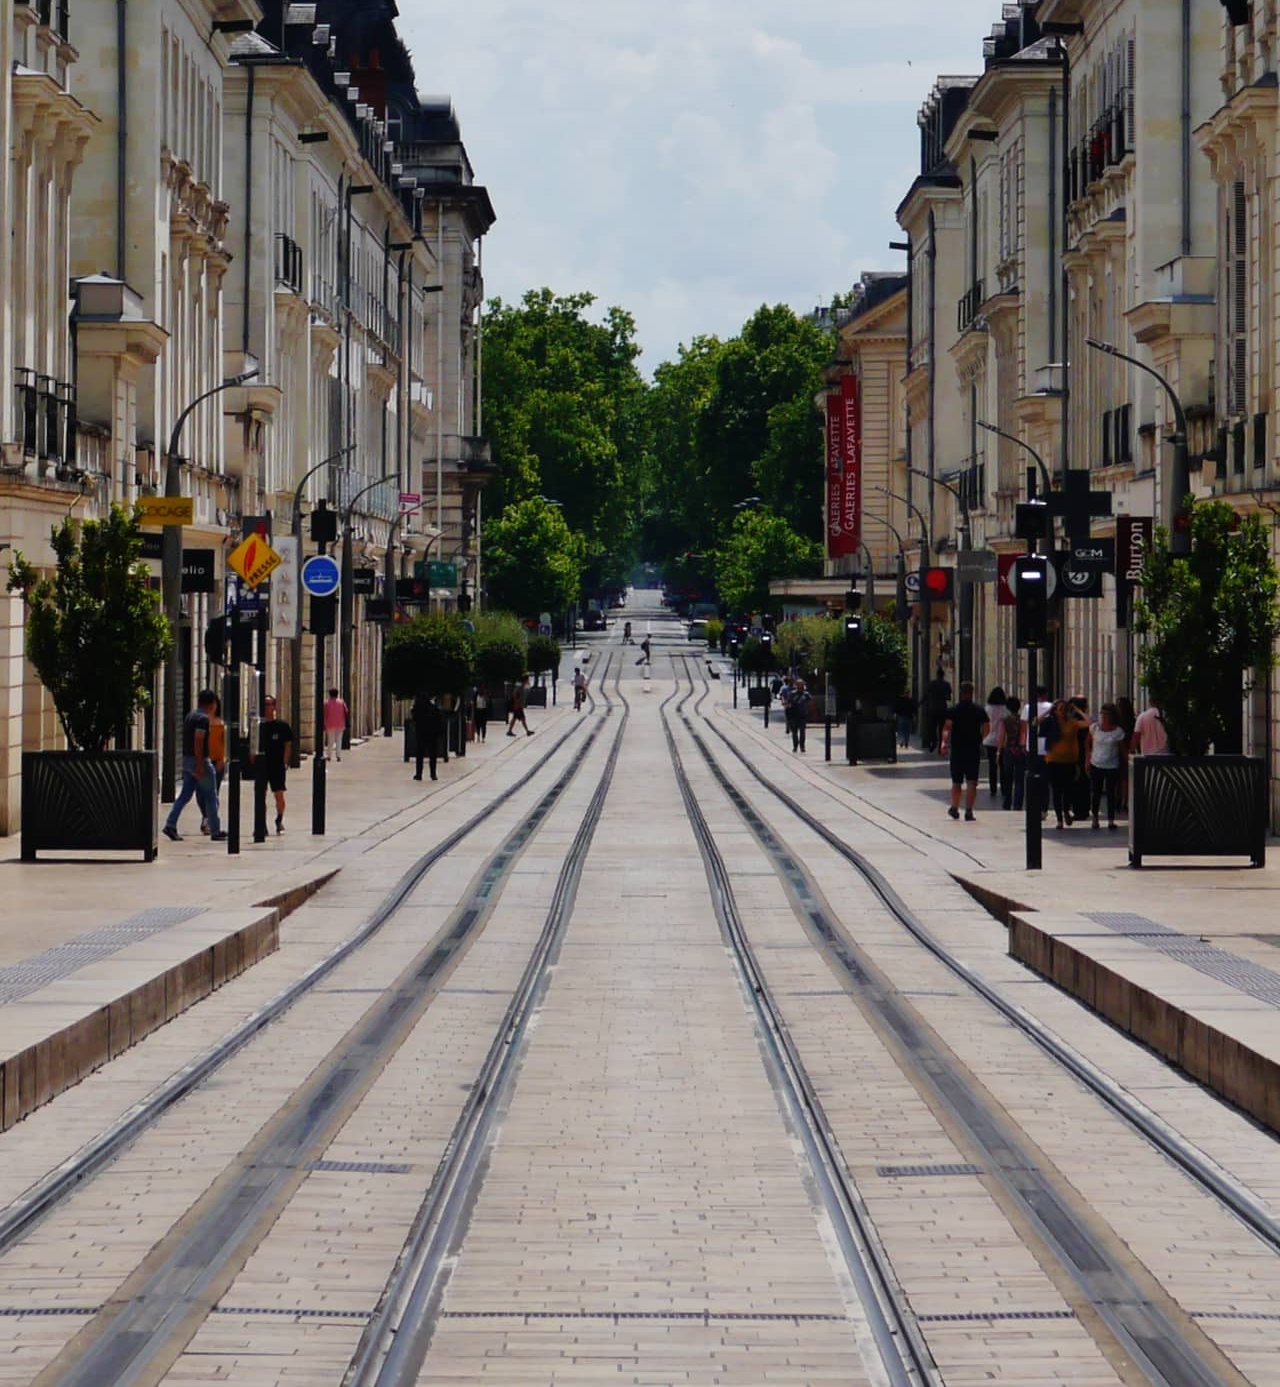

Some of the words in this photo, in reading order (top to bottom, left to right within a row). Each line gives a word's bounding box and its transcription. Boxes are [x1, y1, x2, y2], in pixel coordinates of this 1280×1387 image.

[846, 398, 855, 464] LAFAYETTE
[147, 506, 192, 517] OCAGE
[845, 472, 855, 530] GALERIES
[181, 565, 205, 575] elio
[248, 554, 278, 584] PRESSE
[1125, 522, 1144, 579] Burton
